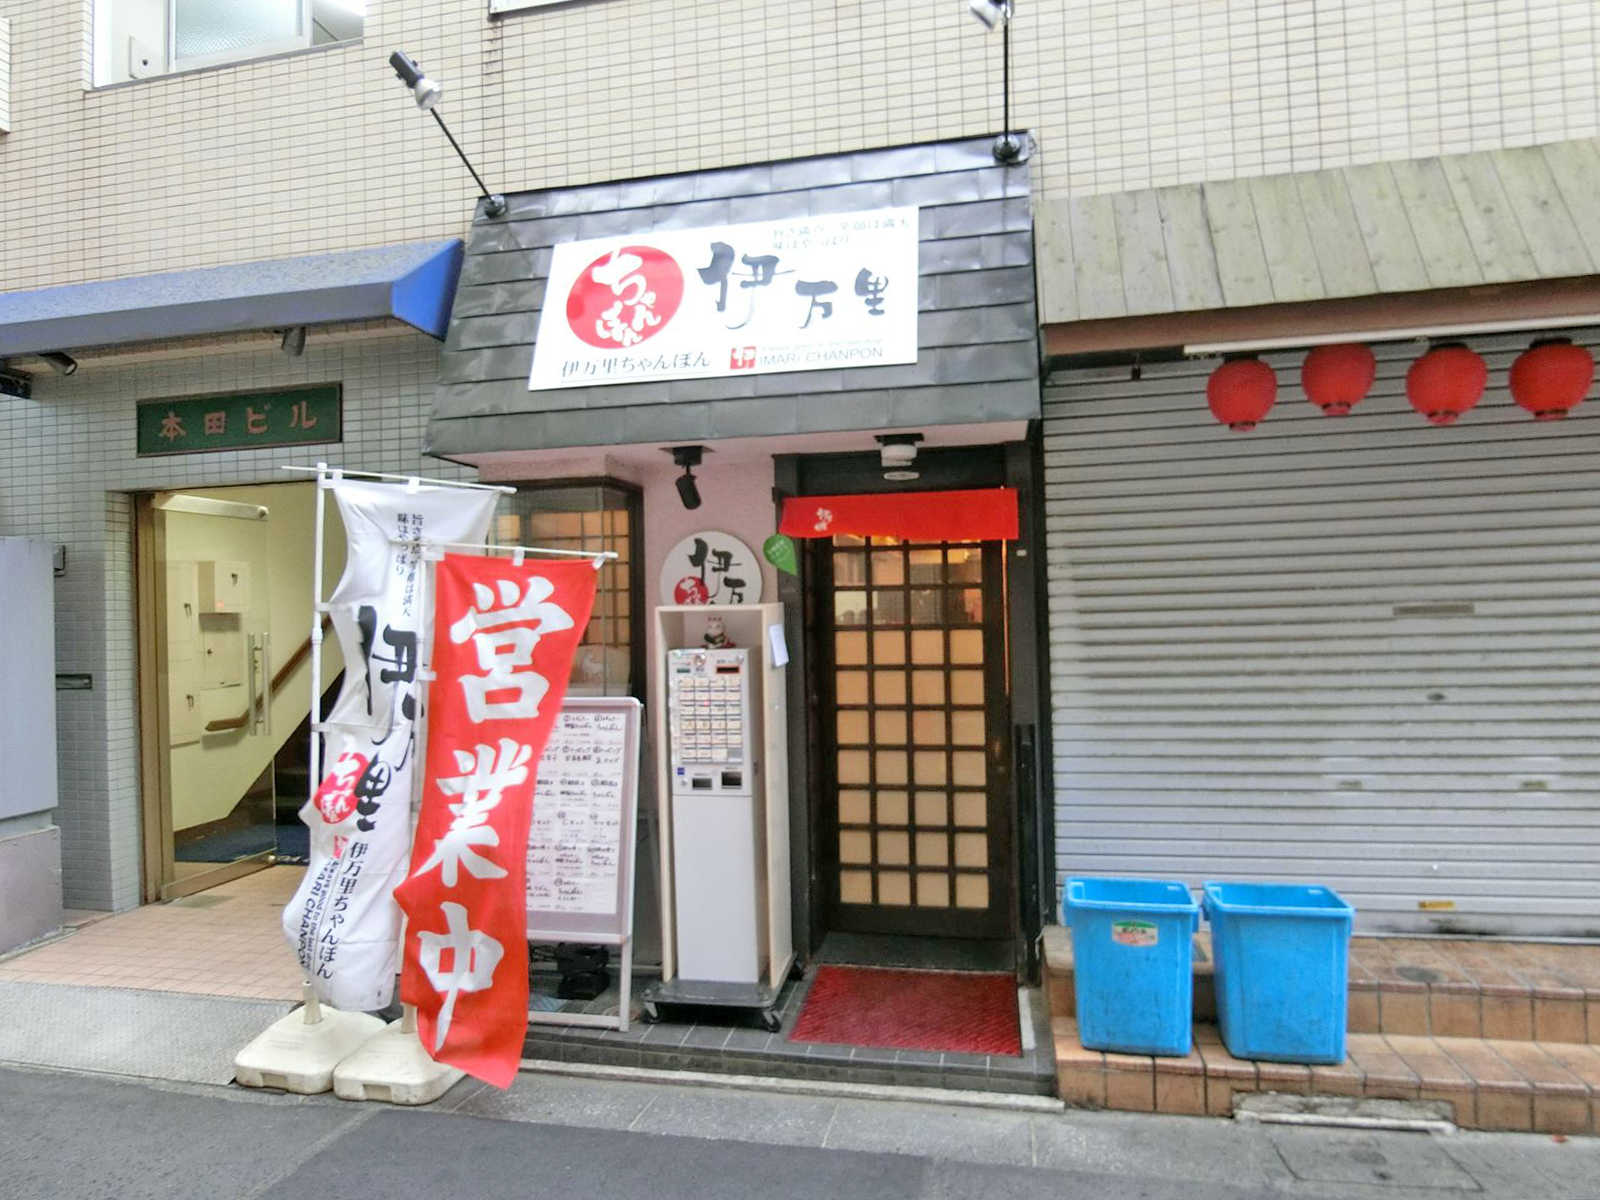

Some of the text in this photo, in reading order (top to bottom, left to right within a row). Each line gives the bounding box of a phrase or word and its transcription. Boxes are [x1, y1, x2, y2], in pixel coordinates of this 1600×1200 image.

[697, 241, 889, 330] 伊万里
[561, 351, 711, 378] 伊万里ちゃんぽん
[760, 347, 883, 366] IMARI CHANPON
[157, 400, 318, 442] 本田ビル
[687, 538, 747, 604] 伊万
[412, 575, 575, 1052] 営業中
[316, 841, 369, 980] 伊万里ちゃんぽん
